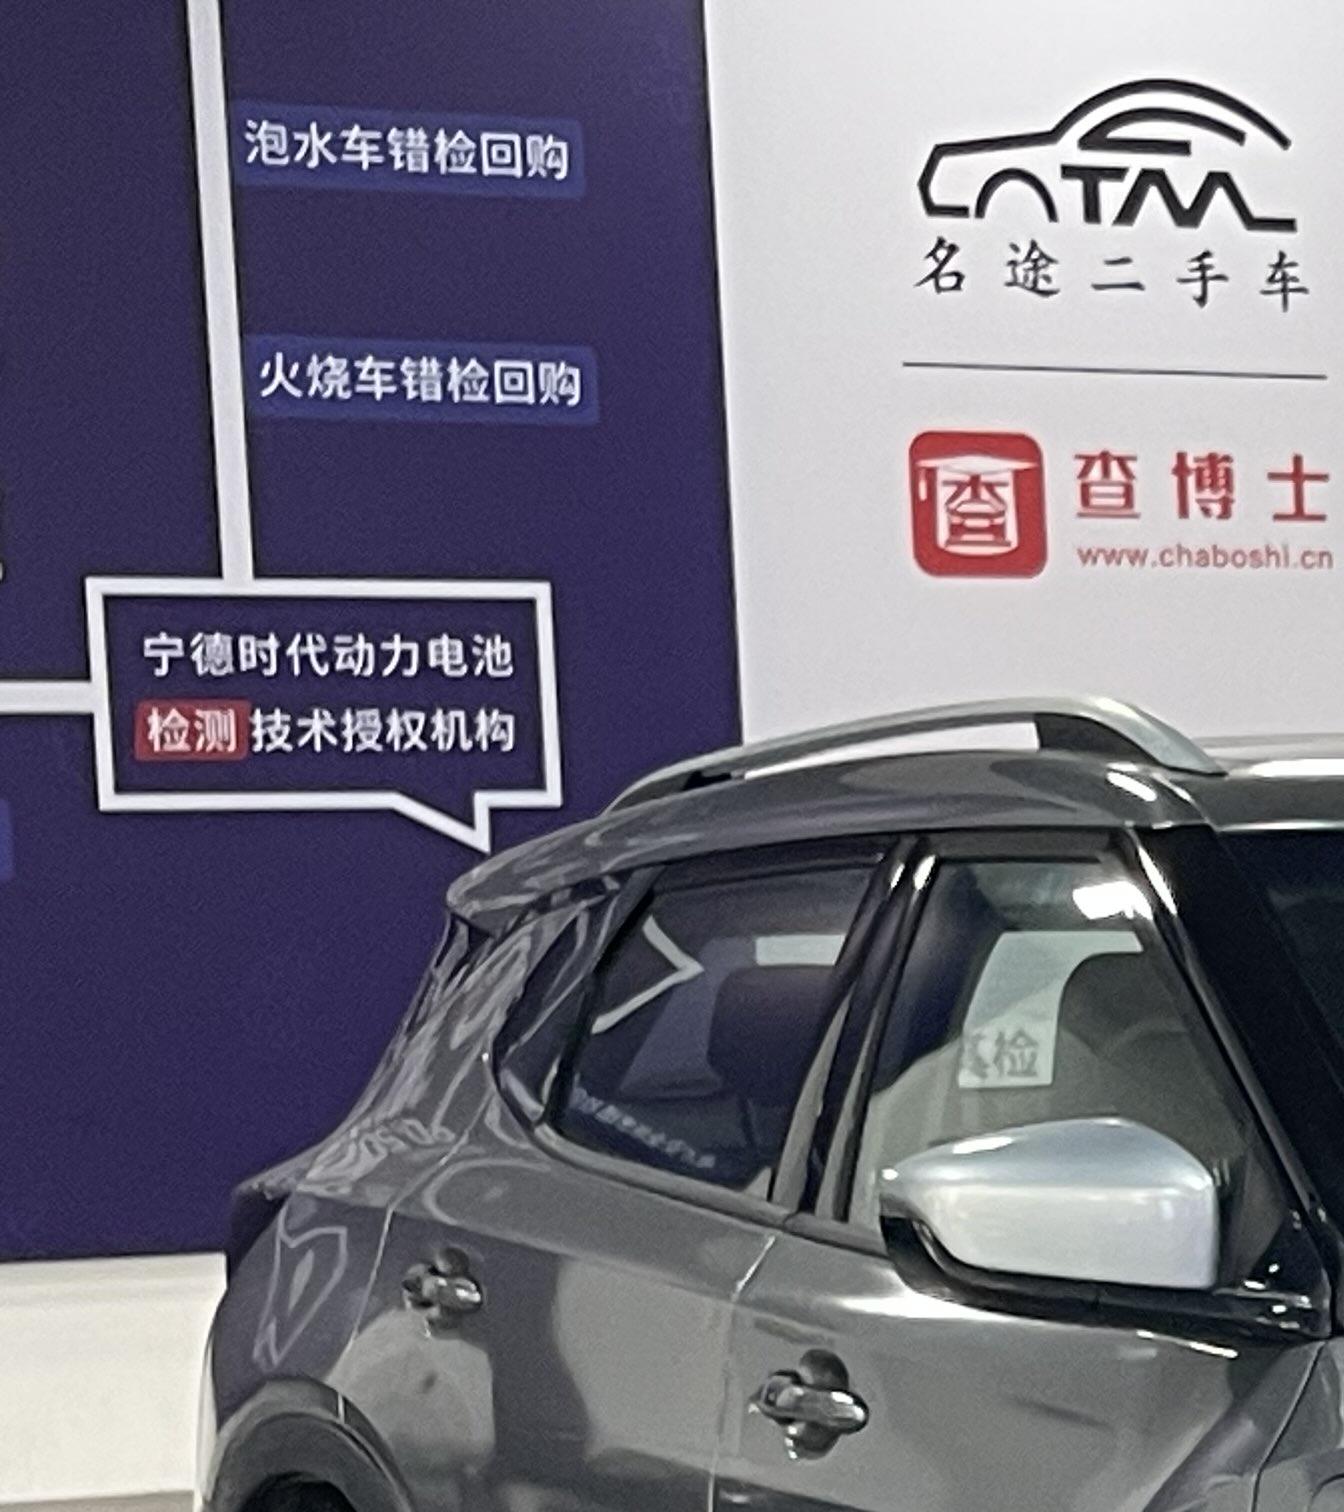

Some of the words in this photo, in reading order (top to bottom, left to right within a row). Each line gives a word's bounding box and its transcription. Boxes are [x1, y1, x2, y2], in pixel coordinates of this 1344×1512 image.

[245, 119, 570, 181] 泡水车错检回购
[913, 235, 1311, 313] 名途二手车
[260, 351, 582, 407] 火烧车错检回购
[1073, 449, 1331, 523] 查博士
[1076, 543, 1334, 571] www.chaboshi.cn
[142, 631, 514, 678] 宁德时代动力电池
